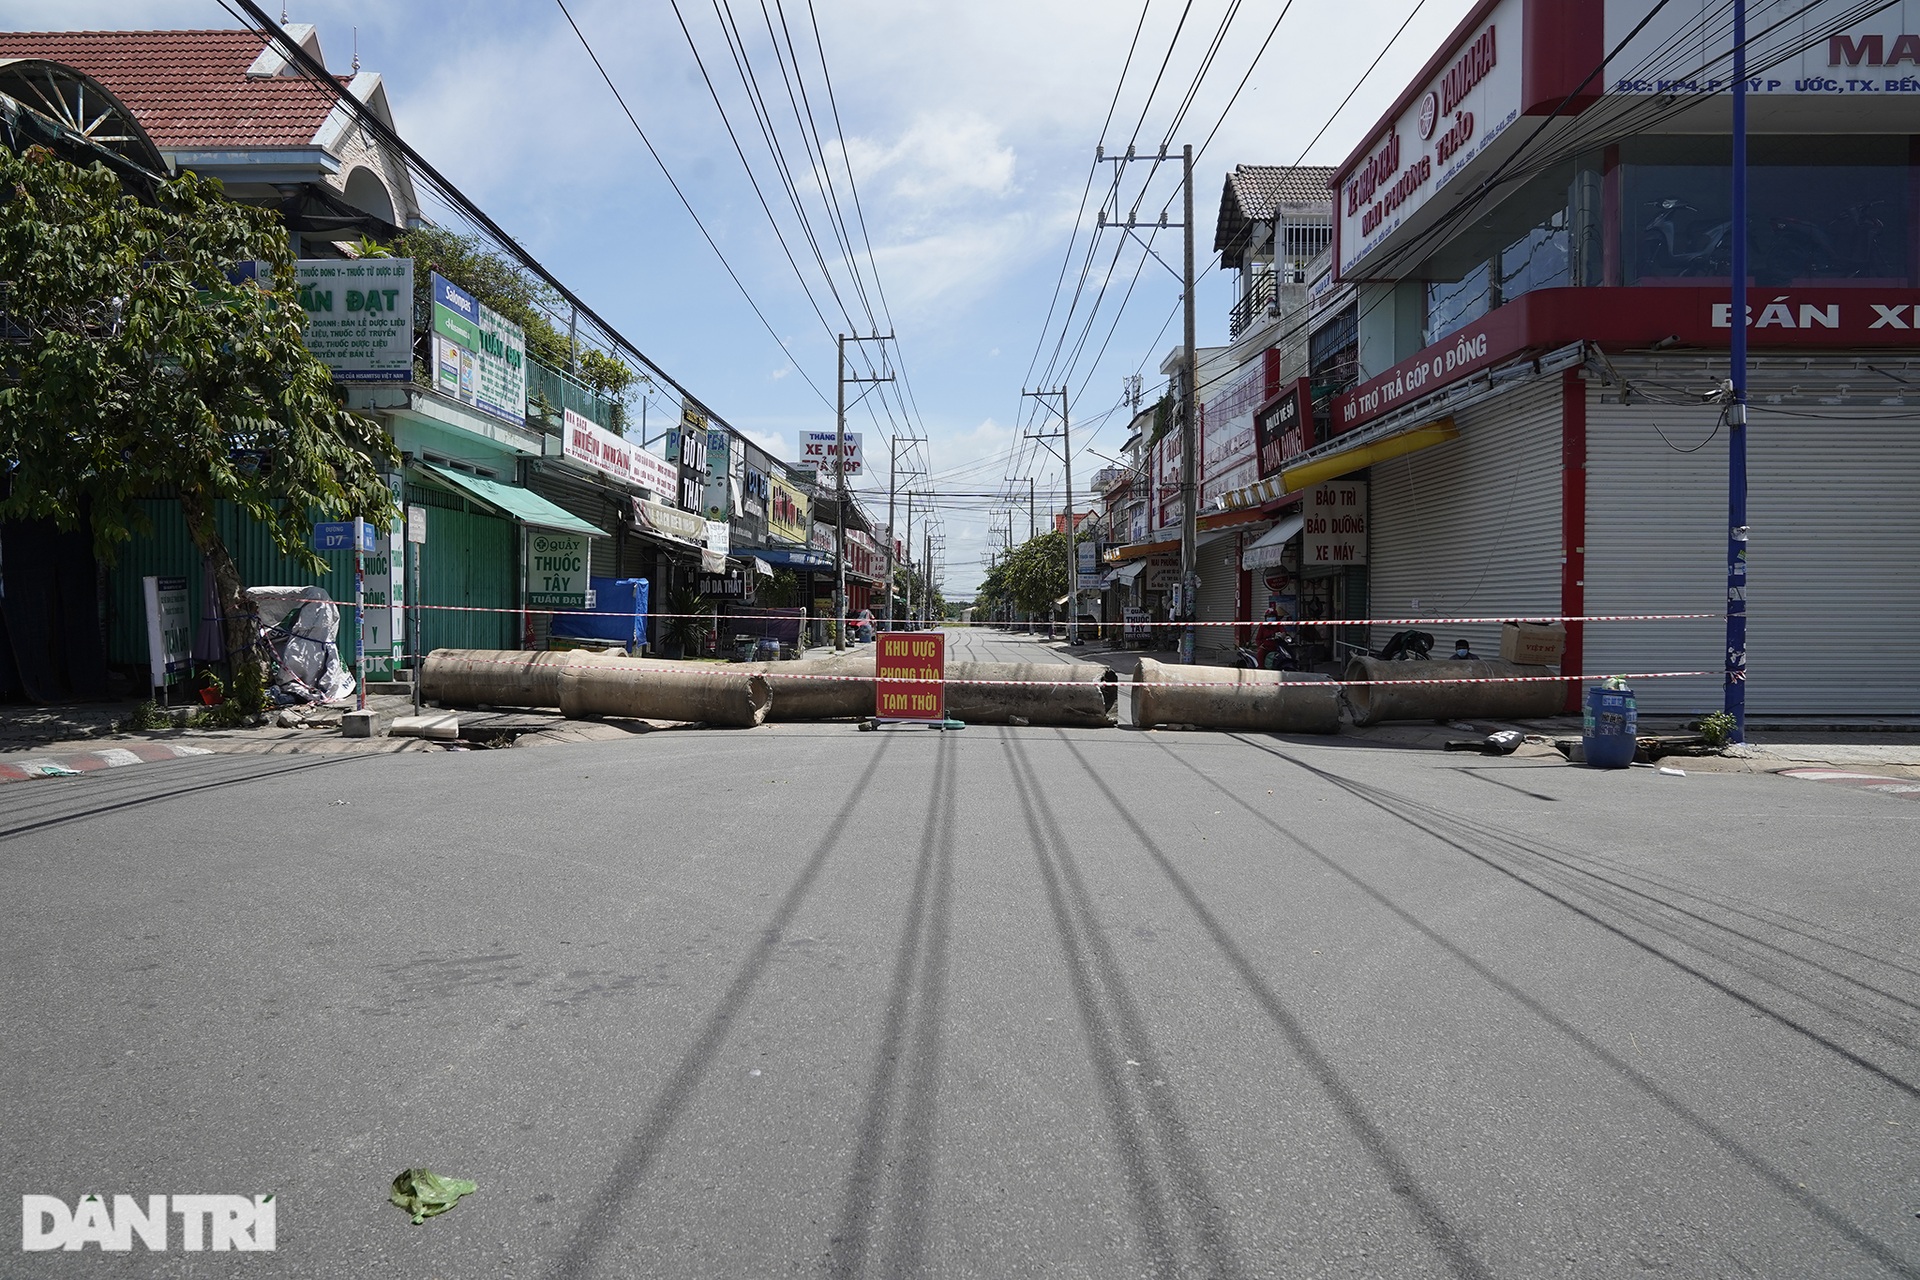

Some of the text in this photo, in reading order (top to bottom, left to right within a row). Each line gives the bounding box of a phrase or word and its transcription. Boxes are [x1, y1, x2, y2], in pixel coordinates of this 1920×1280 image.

[1440, 25, 1497, 118] YAMAHA
[1846, 79, 1879, 92] TX.
[1348, 180, 1358, 217] XE
[1359, 156, 1378, 206] NHẬP
[1378, 125, 1399, 186] KHẨU
[1362, 201, 1382, 237] MAI
[1384, 155, 1431, 217] PHƯƠNG
[1435, 110, 1474, 166] THẢO
[347, 265, 366, 277] THUỐC
[376, 267, 391, 278] DƯỢC
[393, 266, 405, 277] LIỆU
[346, 289, 399, 317] ĐẠT
[445, 285, 472, 313] Salonpas
[1711, 295, 1920, 329] BÁN X
[330, 328, 353, 337] THUỐC
[341, 318, 356, 327] BÁN
[369, 319, 388, 328] DƯỢC
[390, 318, 406, 328] LIỆU
[326, 338, 349, 347] THUỐC
[351, 339, 370, 348] DƯỢC
[373, 339, 388, 348] LIỆU
[349, 349, 364, 357] BÁN
[479, 329, 504, 359] TUẤN
[1343, 392, 1357, 423] HỖ
[1359, 386, 1379, 413] TRỢ
[1381, 370, 1404, 403] TRẢ
[1406, 360, 1430, 391] GÓP
[1445, 333, 1487, 372] ĐỒNG
[603, 443, 630, 471] NHÂN
[696, 441, 707, 474] DA
[805, 443, 823, 455] XE
[683, 477, 704, 516] THẬT
[1315, 484, 1356, 506] BẢO TRÌ
[325, 525, 344, 533] ĐƯỜNG
[1306, 512, 1364, 534] BẢO DƯỠNG
[326, 535, 344, 546] D7
[549, 537, 580, 552] QUẦY
[534, 551, 581, 572] THUỐC
[1316, 542, 1355, 561] XE MÁY
[543, 573, 571, 592] TÂY
[712, 580, 723, 594] DA
[532, 593, 584, 606] TUẤN ĐẠT
[372, 626, 378, 644] Y
[885, 640, 936, 660] KHU VỰC
[364, 654, 389, 673] OK
[880, 664, 940, 684] PHONG TỎA
[883, 692, 937, 713] TẠM THỜI
